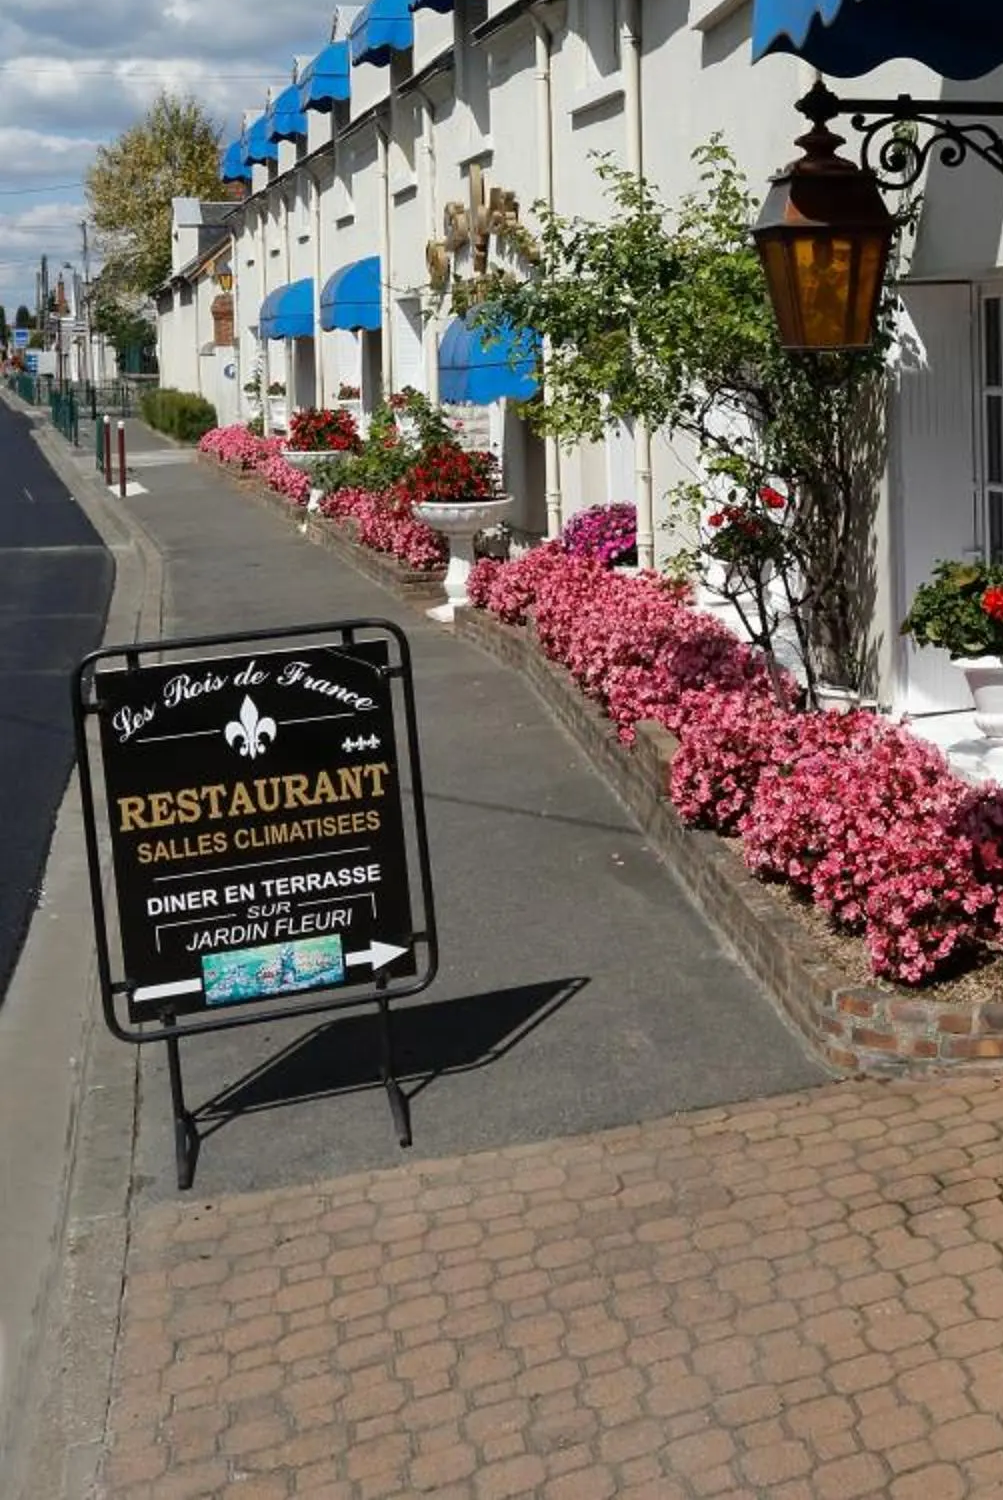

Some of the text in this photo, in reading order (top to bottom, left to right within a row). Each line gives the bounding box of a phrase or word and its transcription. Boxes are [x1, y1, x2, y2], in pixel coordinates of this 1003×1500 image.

[112, 660, 379, 743] Les Rois de France
[116, 762, 390, 832] RESTAURANT
[136, 809, 382, 864] SALLES CLIMATISEES
[147, 863, 383, 917] DINER EN TERRASSE
[246, 901, 293, 920] SUR
[185, 907, 353, 952] JARDIN FLEURI
